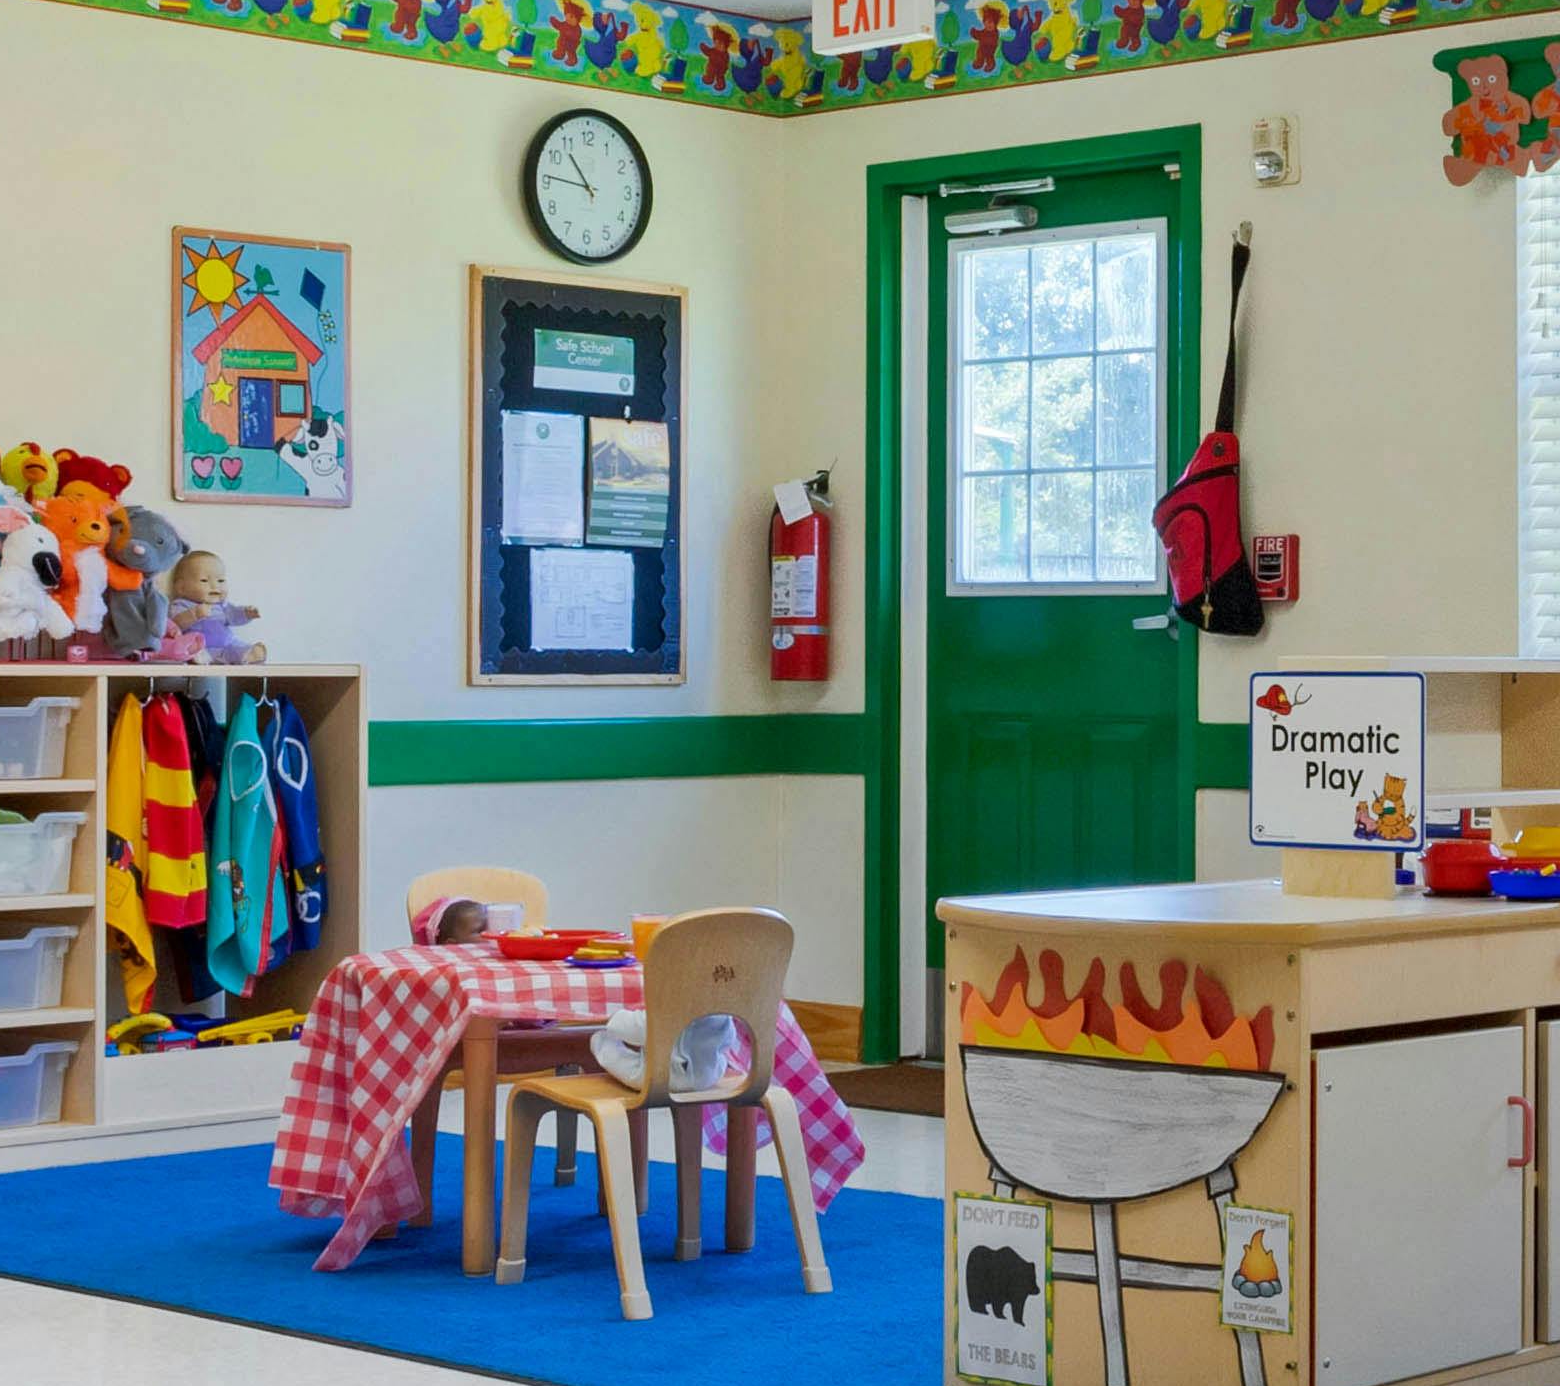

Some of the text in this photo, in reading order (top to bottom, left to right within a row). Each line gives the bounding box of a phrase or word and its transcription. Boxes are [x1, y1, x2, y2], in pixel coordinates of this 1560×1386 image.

[561, 136, 574, 151] 11
[581, 131, 595, 147] 12
[548, 150, 562, 165] 10
[604, 142, 609, 157] 1
[617, 159, 626, 175] 2
[623, 185, 632, 201] 3
[547, 199, 557, 216] 8
[617, 210, 625, 224] 4
[562, 220, 572, 236] 7
[602, 225, 611, 241] 5
[582, 229, 591, 245] 6
[555, 337, 615, 356] Safe School
[567, 352, 603, 367] Center
[1255, 537, 1285, 551] FIRE
[1272, 724, 1400, 754] Dramatic
[1305, 760, 1364, 798] Play
[962, 1205, 1040, 1230] DON'T FEED
[968, 1343, 1037, 1371] THE BEARS
